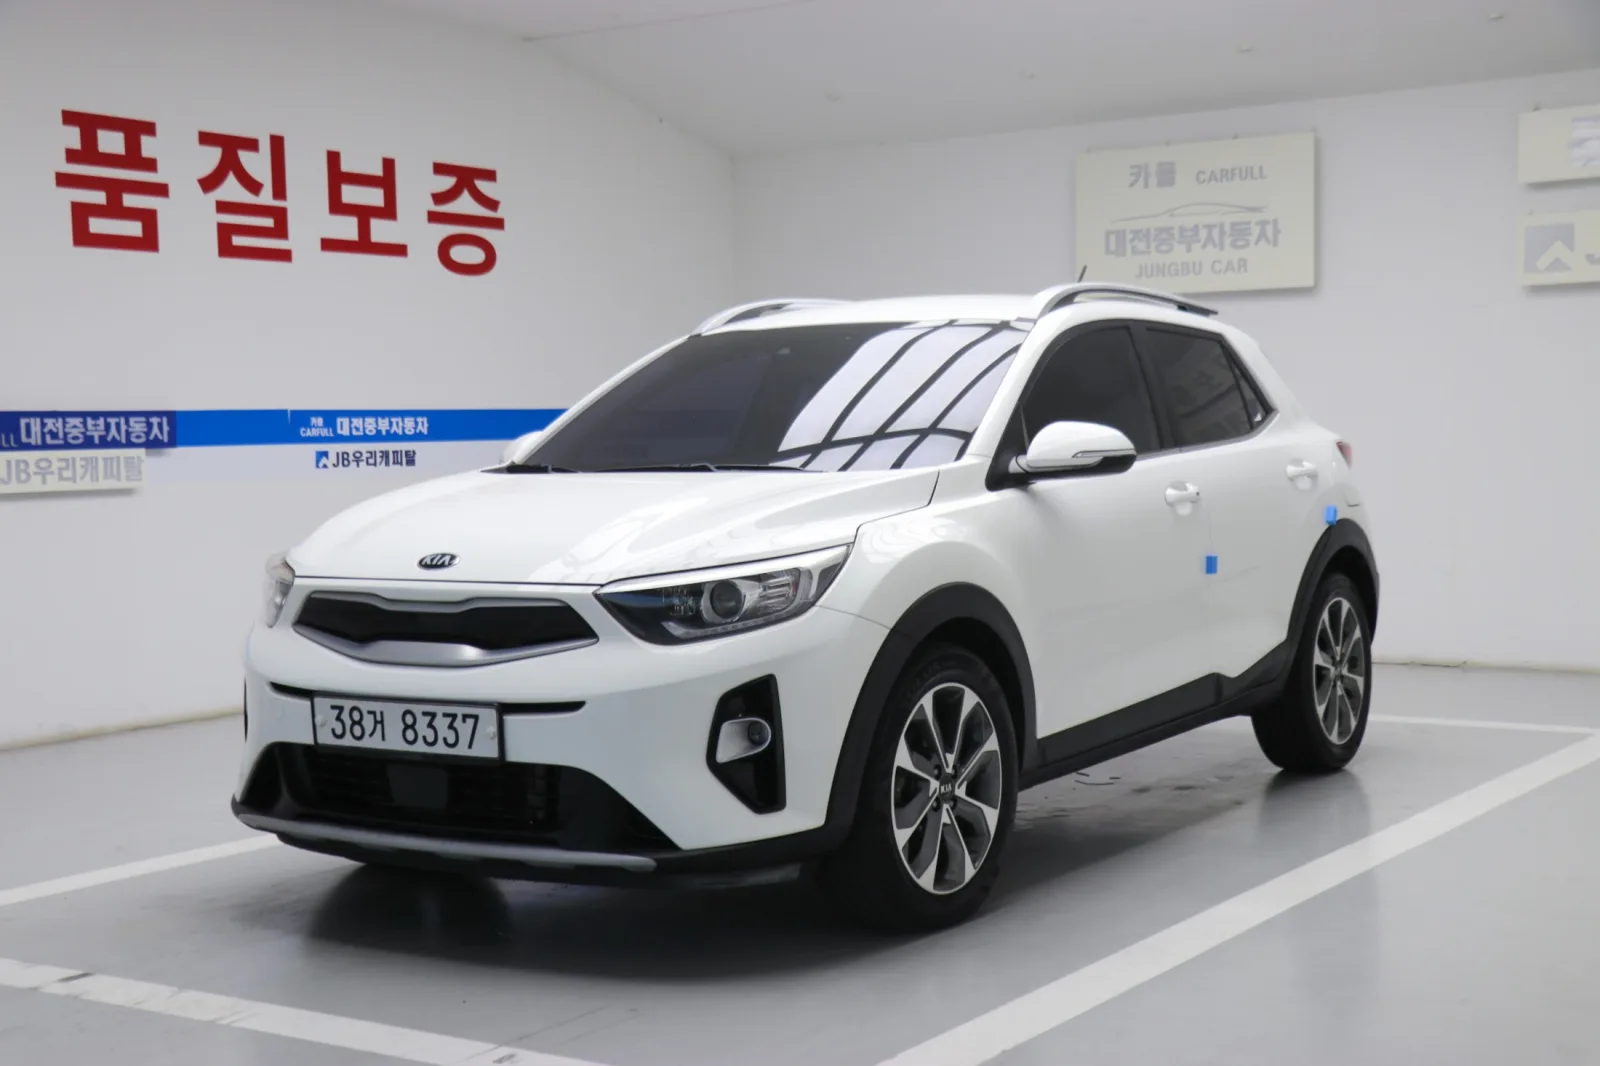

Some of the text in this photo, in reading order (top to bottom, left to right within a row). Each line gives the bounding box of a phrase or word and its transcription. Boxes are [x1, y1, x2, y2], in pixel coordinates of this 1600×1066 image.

[1195, 165, 1268, 185] CARFULL
[1104, 218, 1281, 257] 대전중부자동차
[1135, 257, 1249, 280] JUNGBU CAR
[20, 415, 170, 446] 대전중부자동차
[300, 427, 334, 437] CARFULL
[336, 416, 429, 436] 대전중부자동차
[332, 449, 417, 469] JB우리캐피탈
[0, 455, 144, 486] JB우리캐피탈
[420, 553, 453, 567] KIA
[330, 704, 480, 750] 38거 8337
